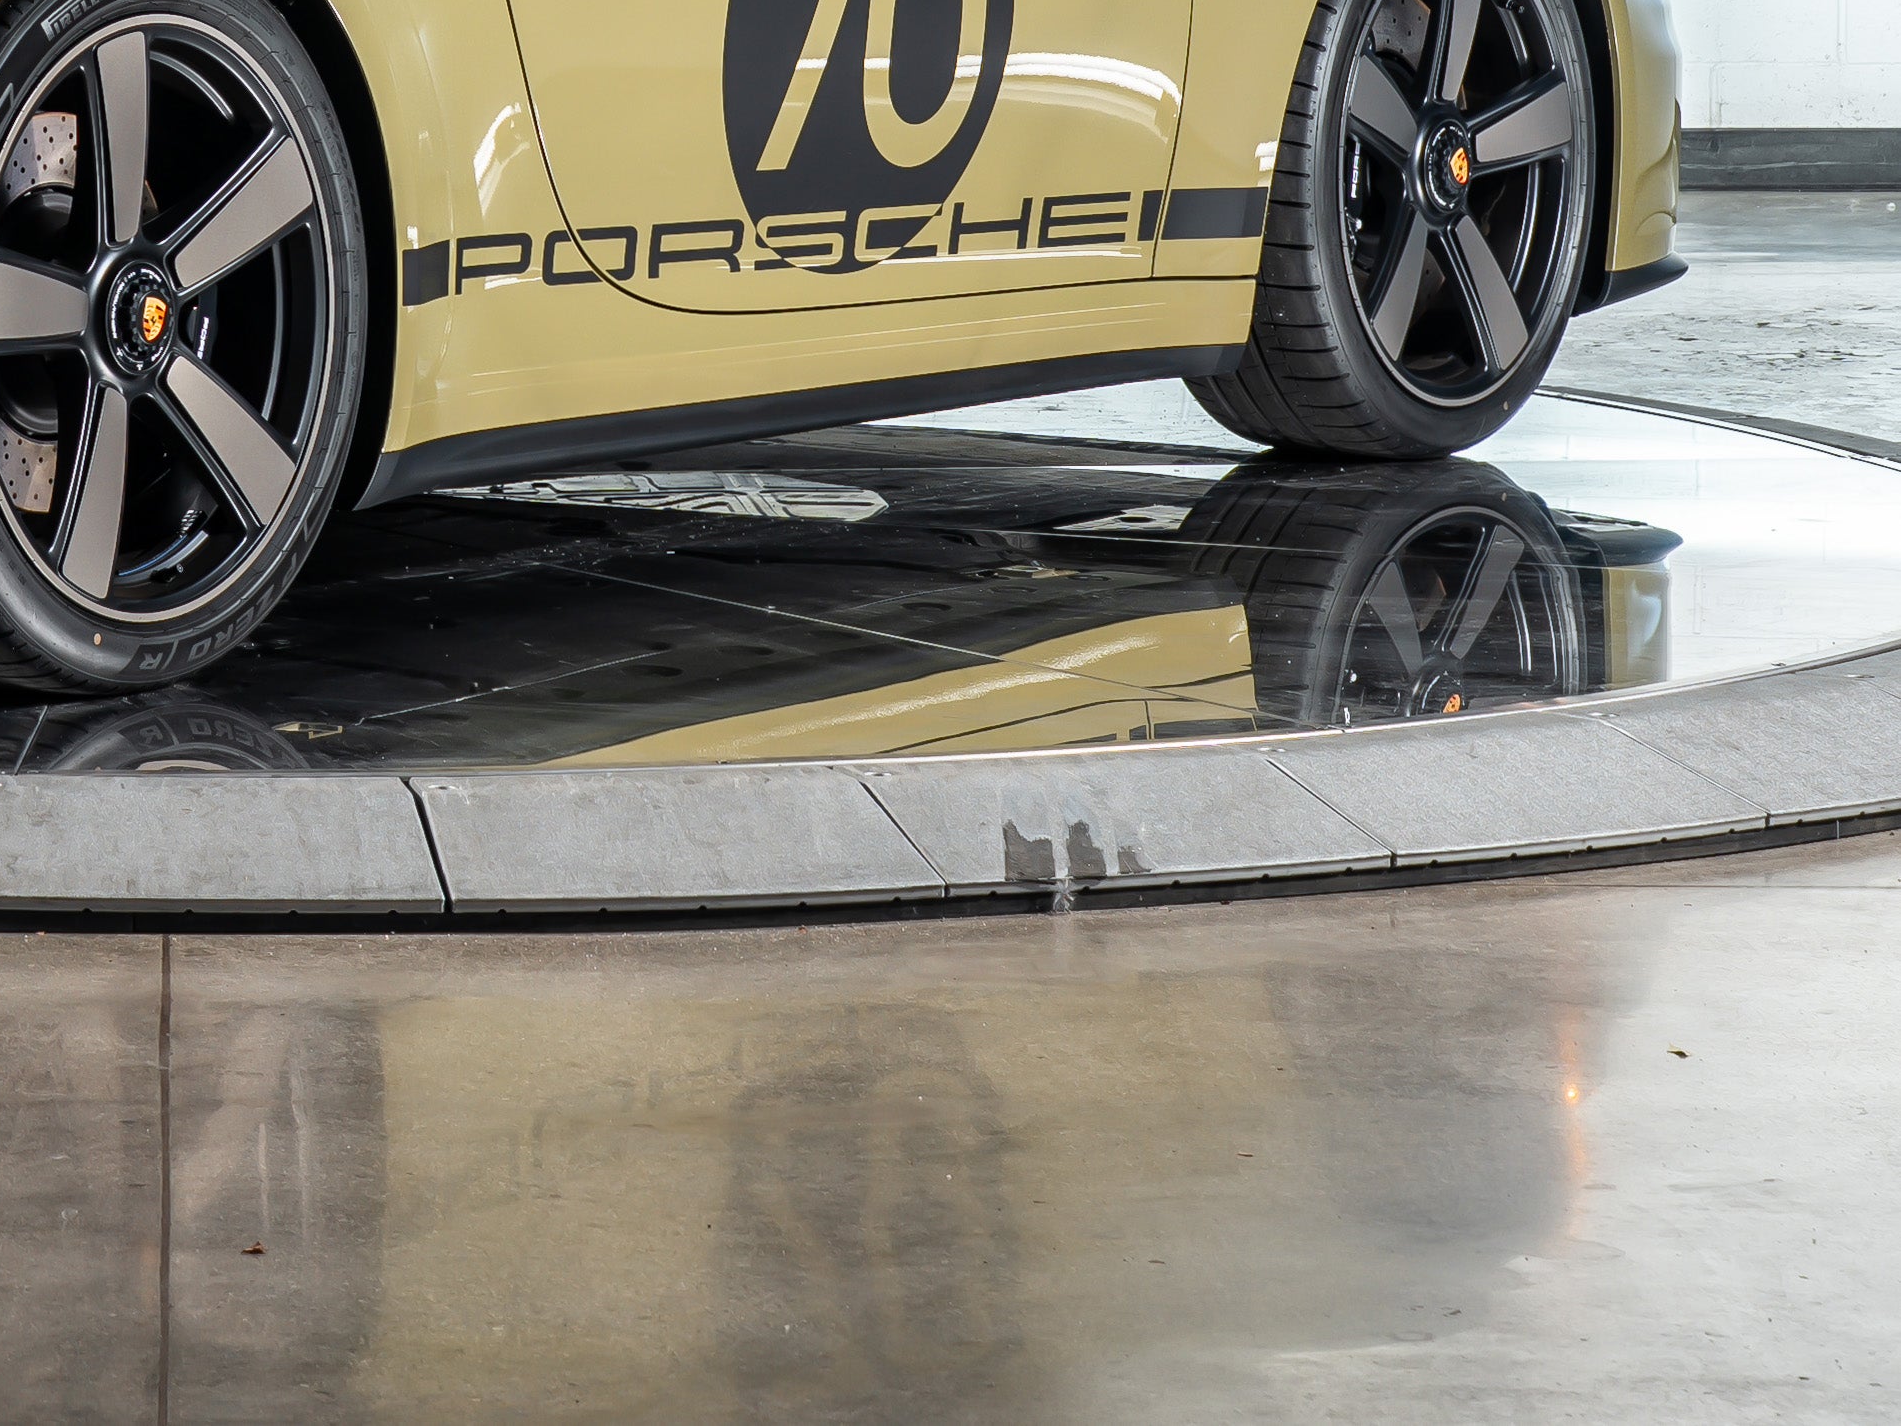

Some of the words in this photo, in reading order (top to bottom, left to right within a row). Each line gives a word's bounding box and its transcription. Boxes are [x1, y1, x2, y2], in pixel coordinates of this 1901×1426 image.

[455, 191, 1132, 295] PORSCHE
[139, 652, 164, 671] R
[188, 584, 275, 662] ZERO
